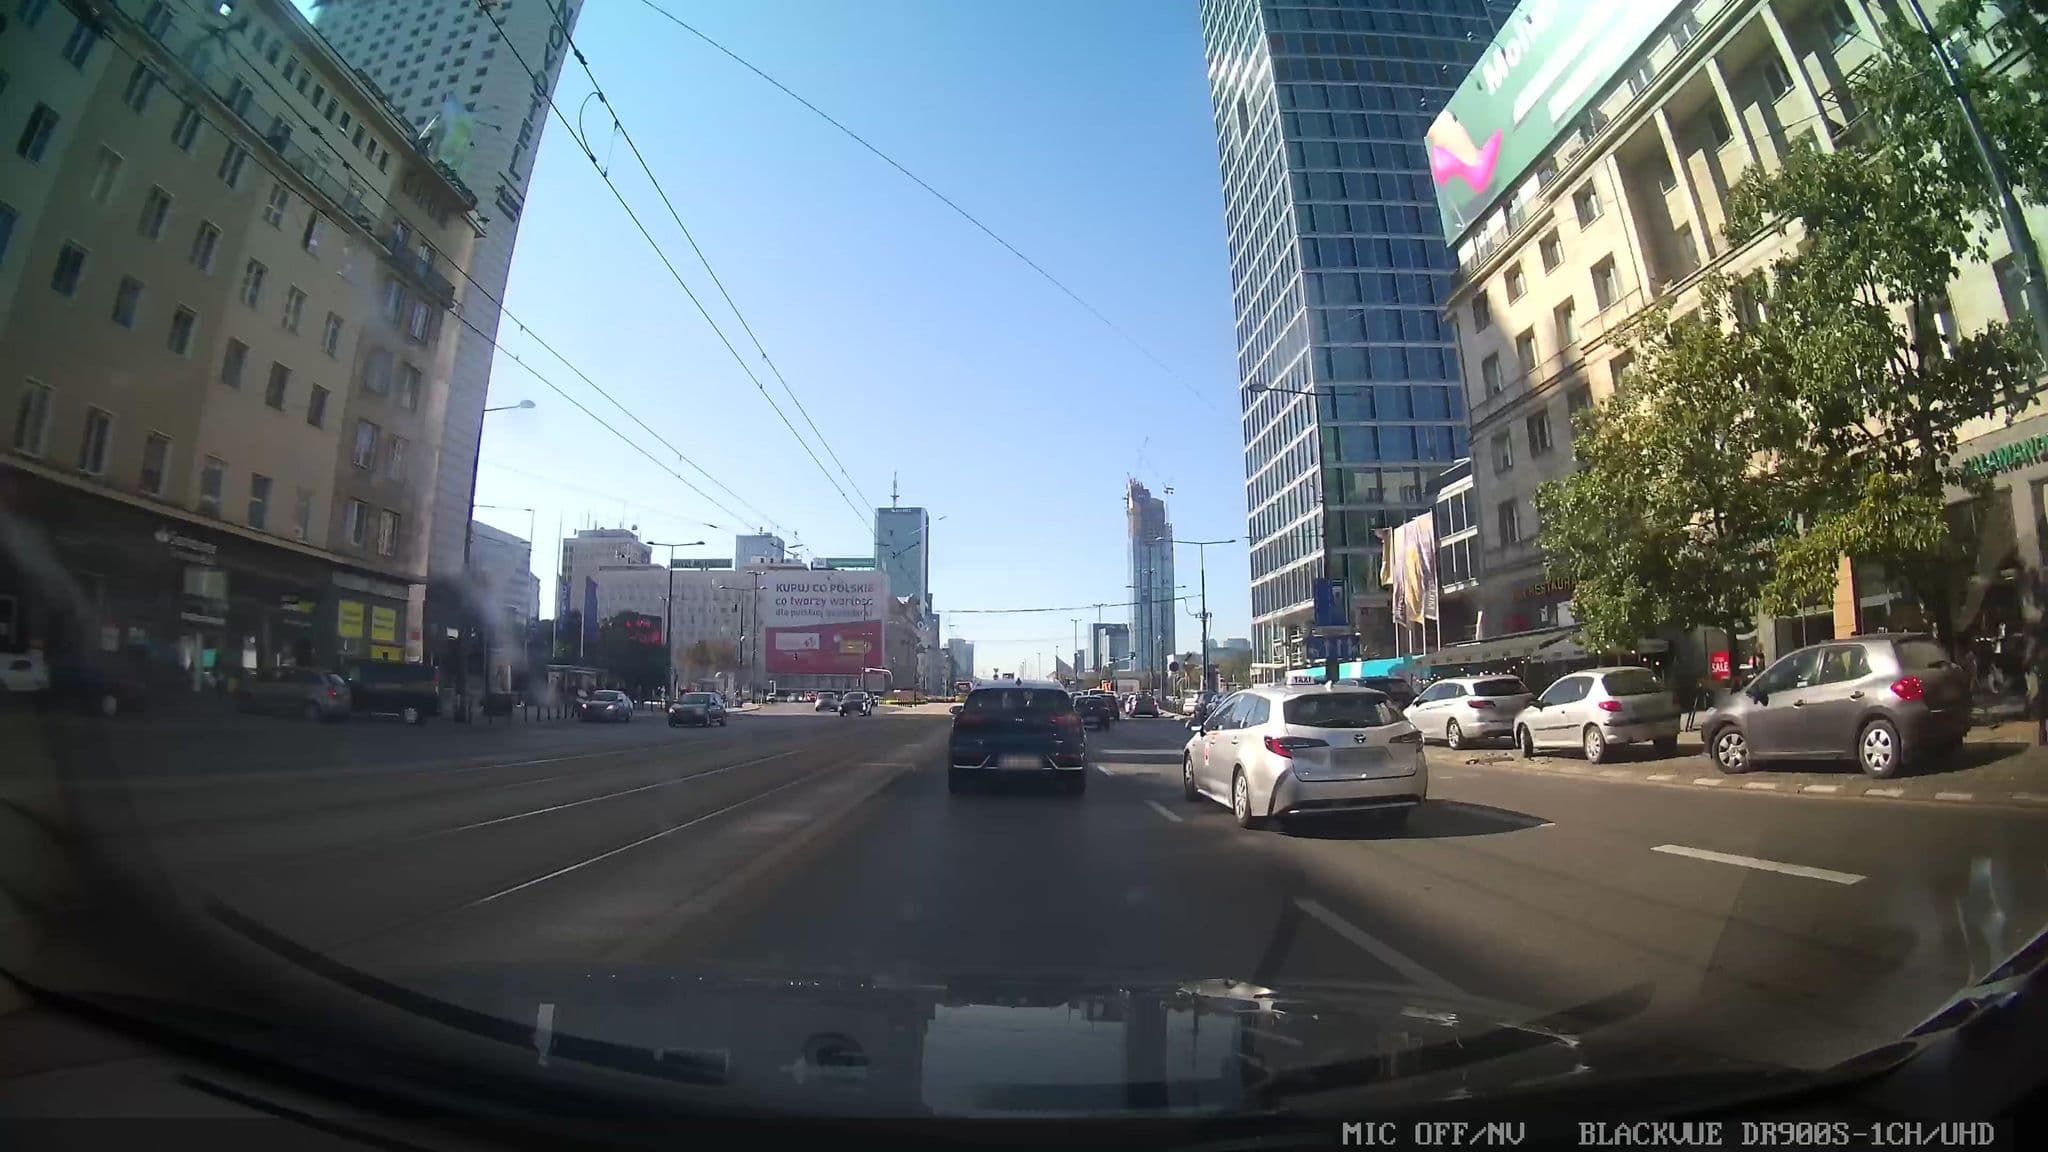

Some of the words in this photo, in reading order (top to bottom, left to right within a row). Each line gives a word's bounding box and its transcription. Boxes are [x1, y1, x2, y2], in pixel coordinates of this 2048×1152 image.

[775, 583, 810, 593] KUPUJ
[812, 583, 828, 593] CO
[830, 583, 875, 593] POLSKIE
[775, 597, 788, 606] co
[1711, 661, 1729, 673] SALE
[1294, 675, 1312, 684] TAXI
